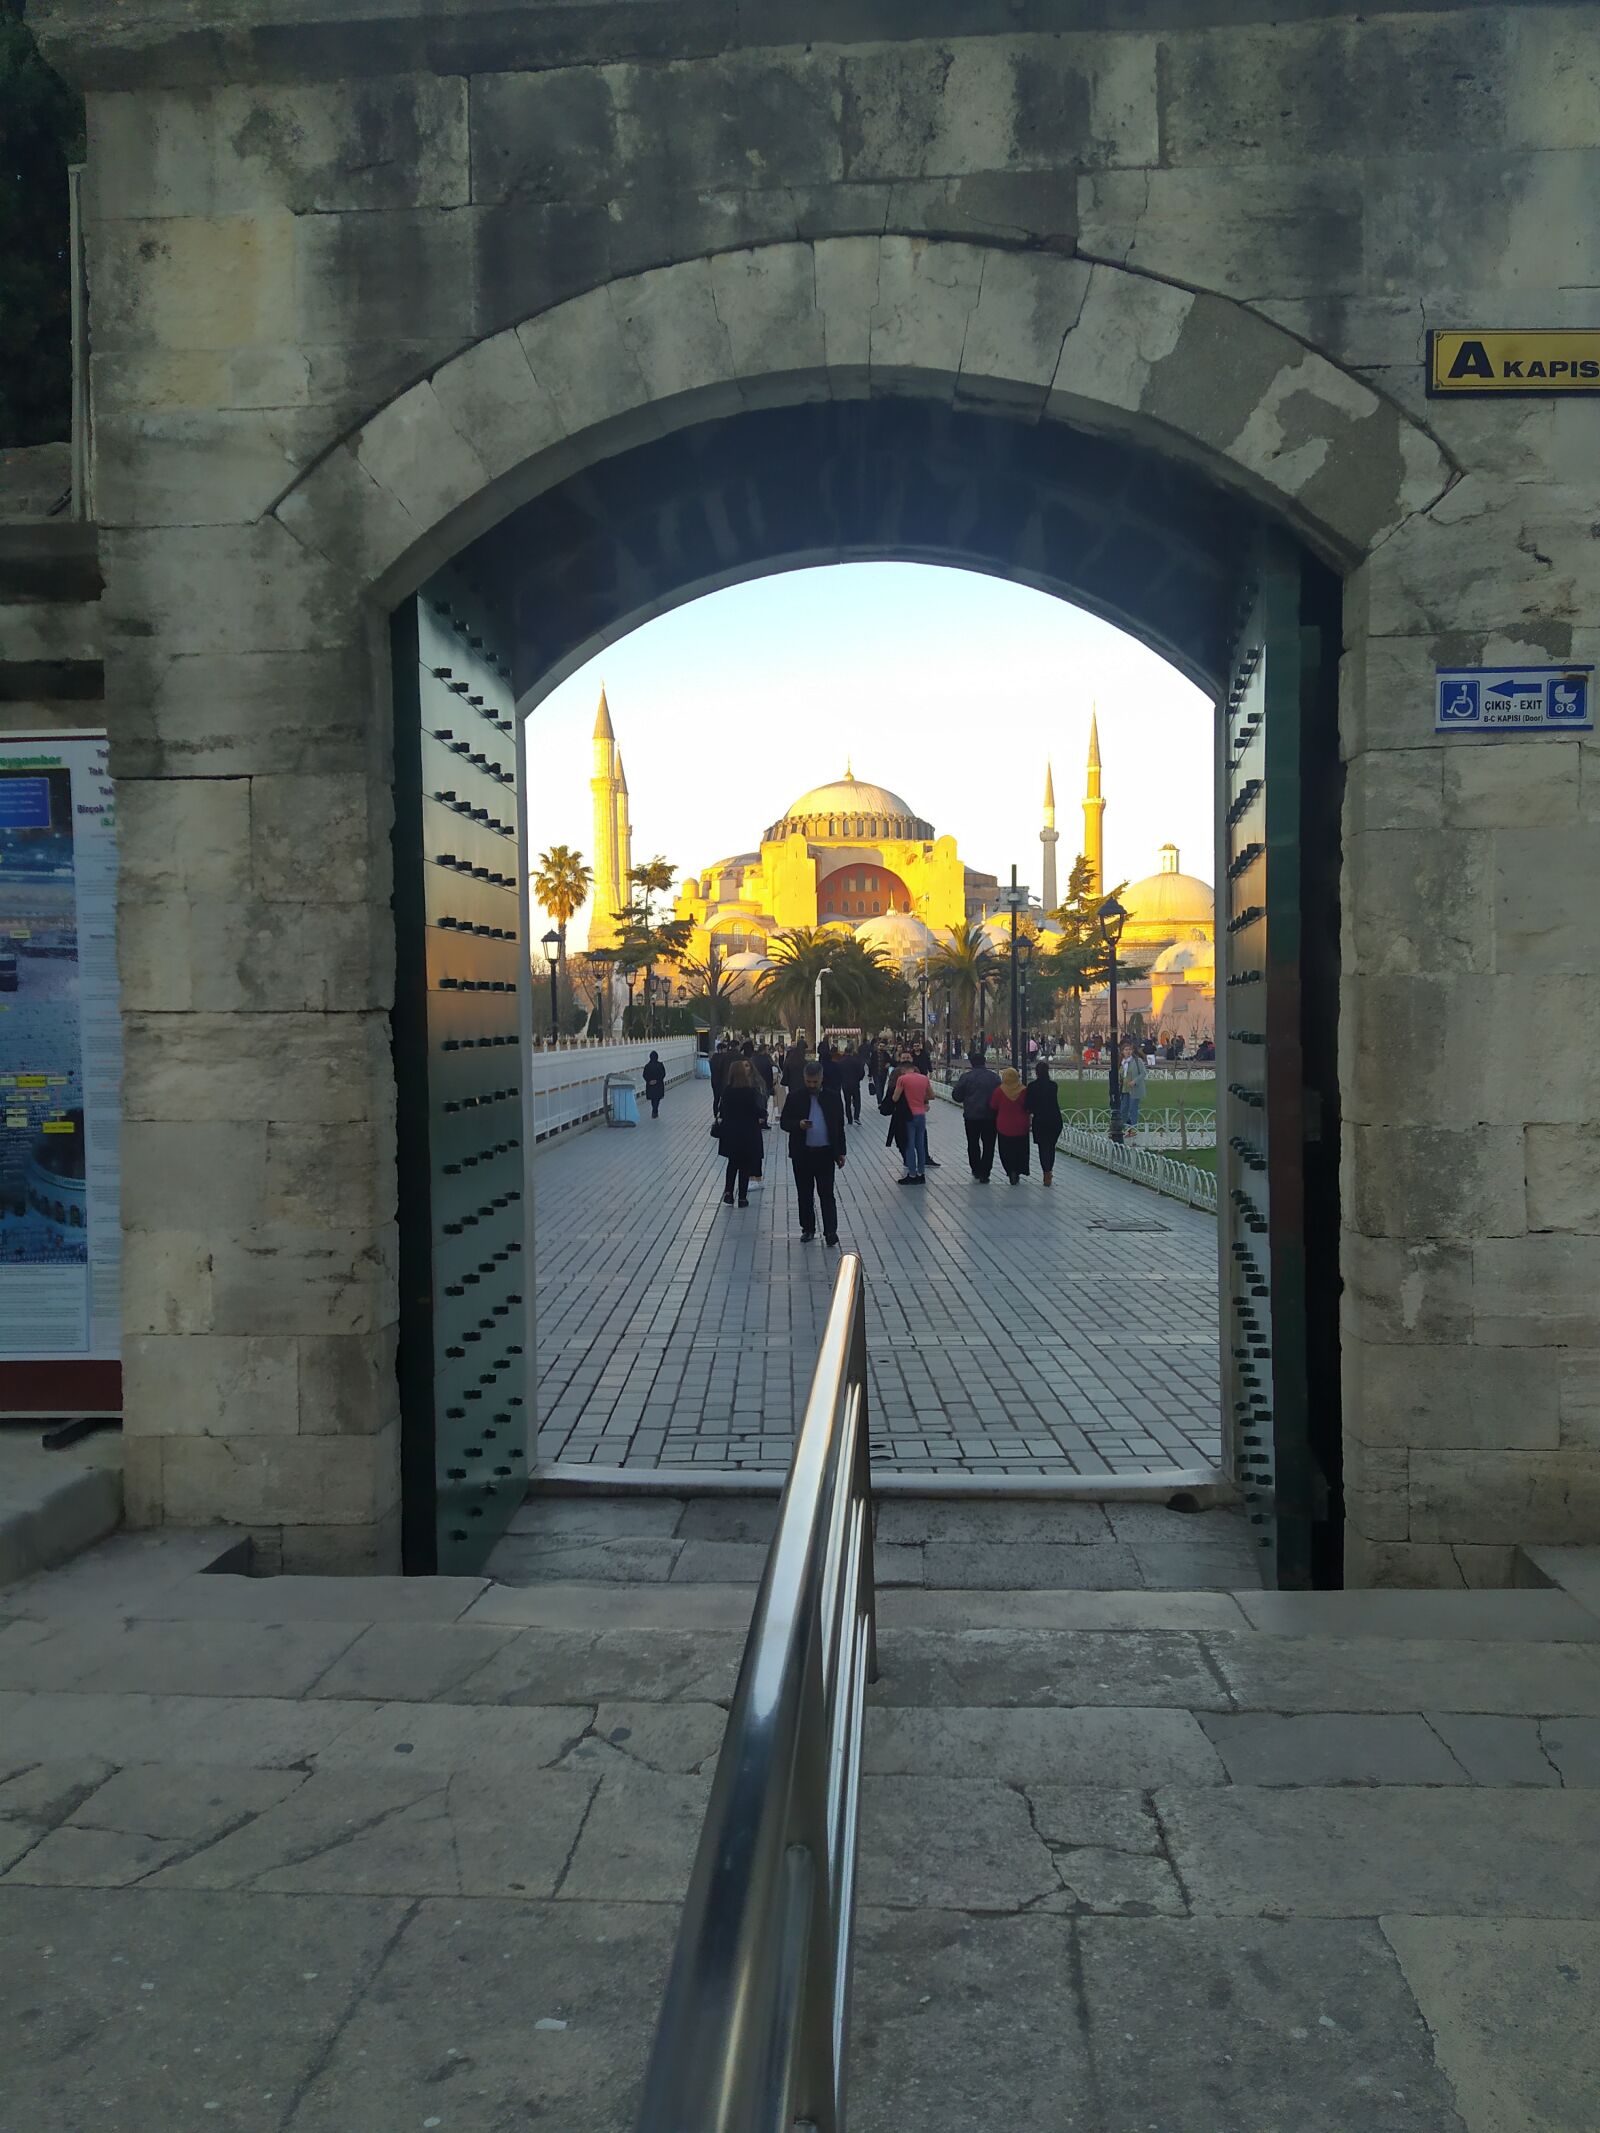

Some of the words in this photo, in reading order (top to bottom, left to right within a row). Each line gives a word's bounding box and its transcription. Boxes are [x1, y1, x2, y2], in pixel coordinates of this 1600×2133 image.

[1447, 341, 1495, 378] A
[1503, 361, 1600, 378] KAPIS
[1484, 700, 1511, 712] ÇIKIŞ
[1520, 700, 1543, 710] EXIT
[1497, 714, 1521, 723] KAPISI
[1522, 714, 1544, 723] (Door)
